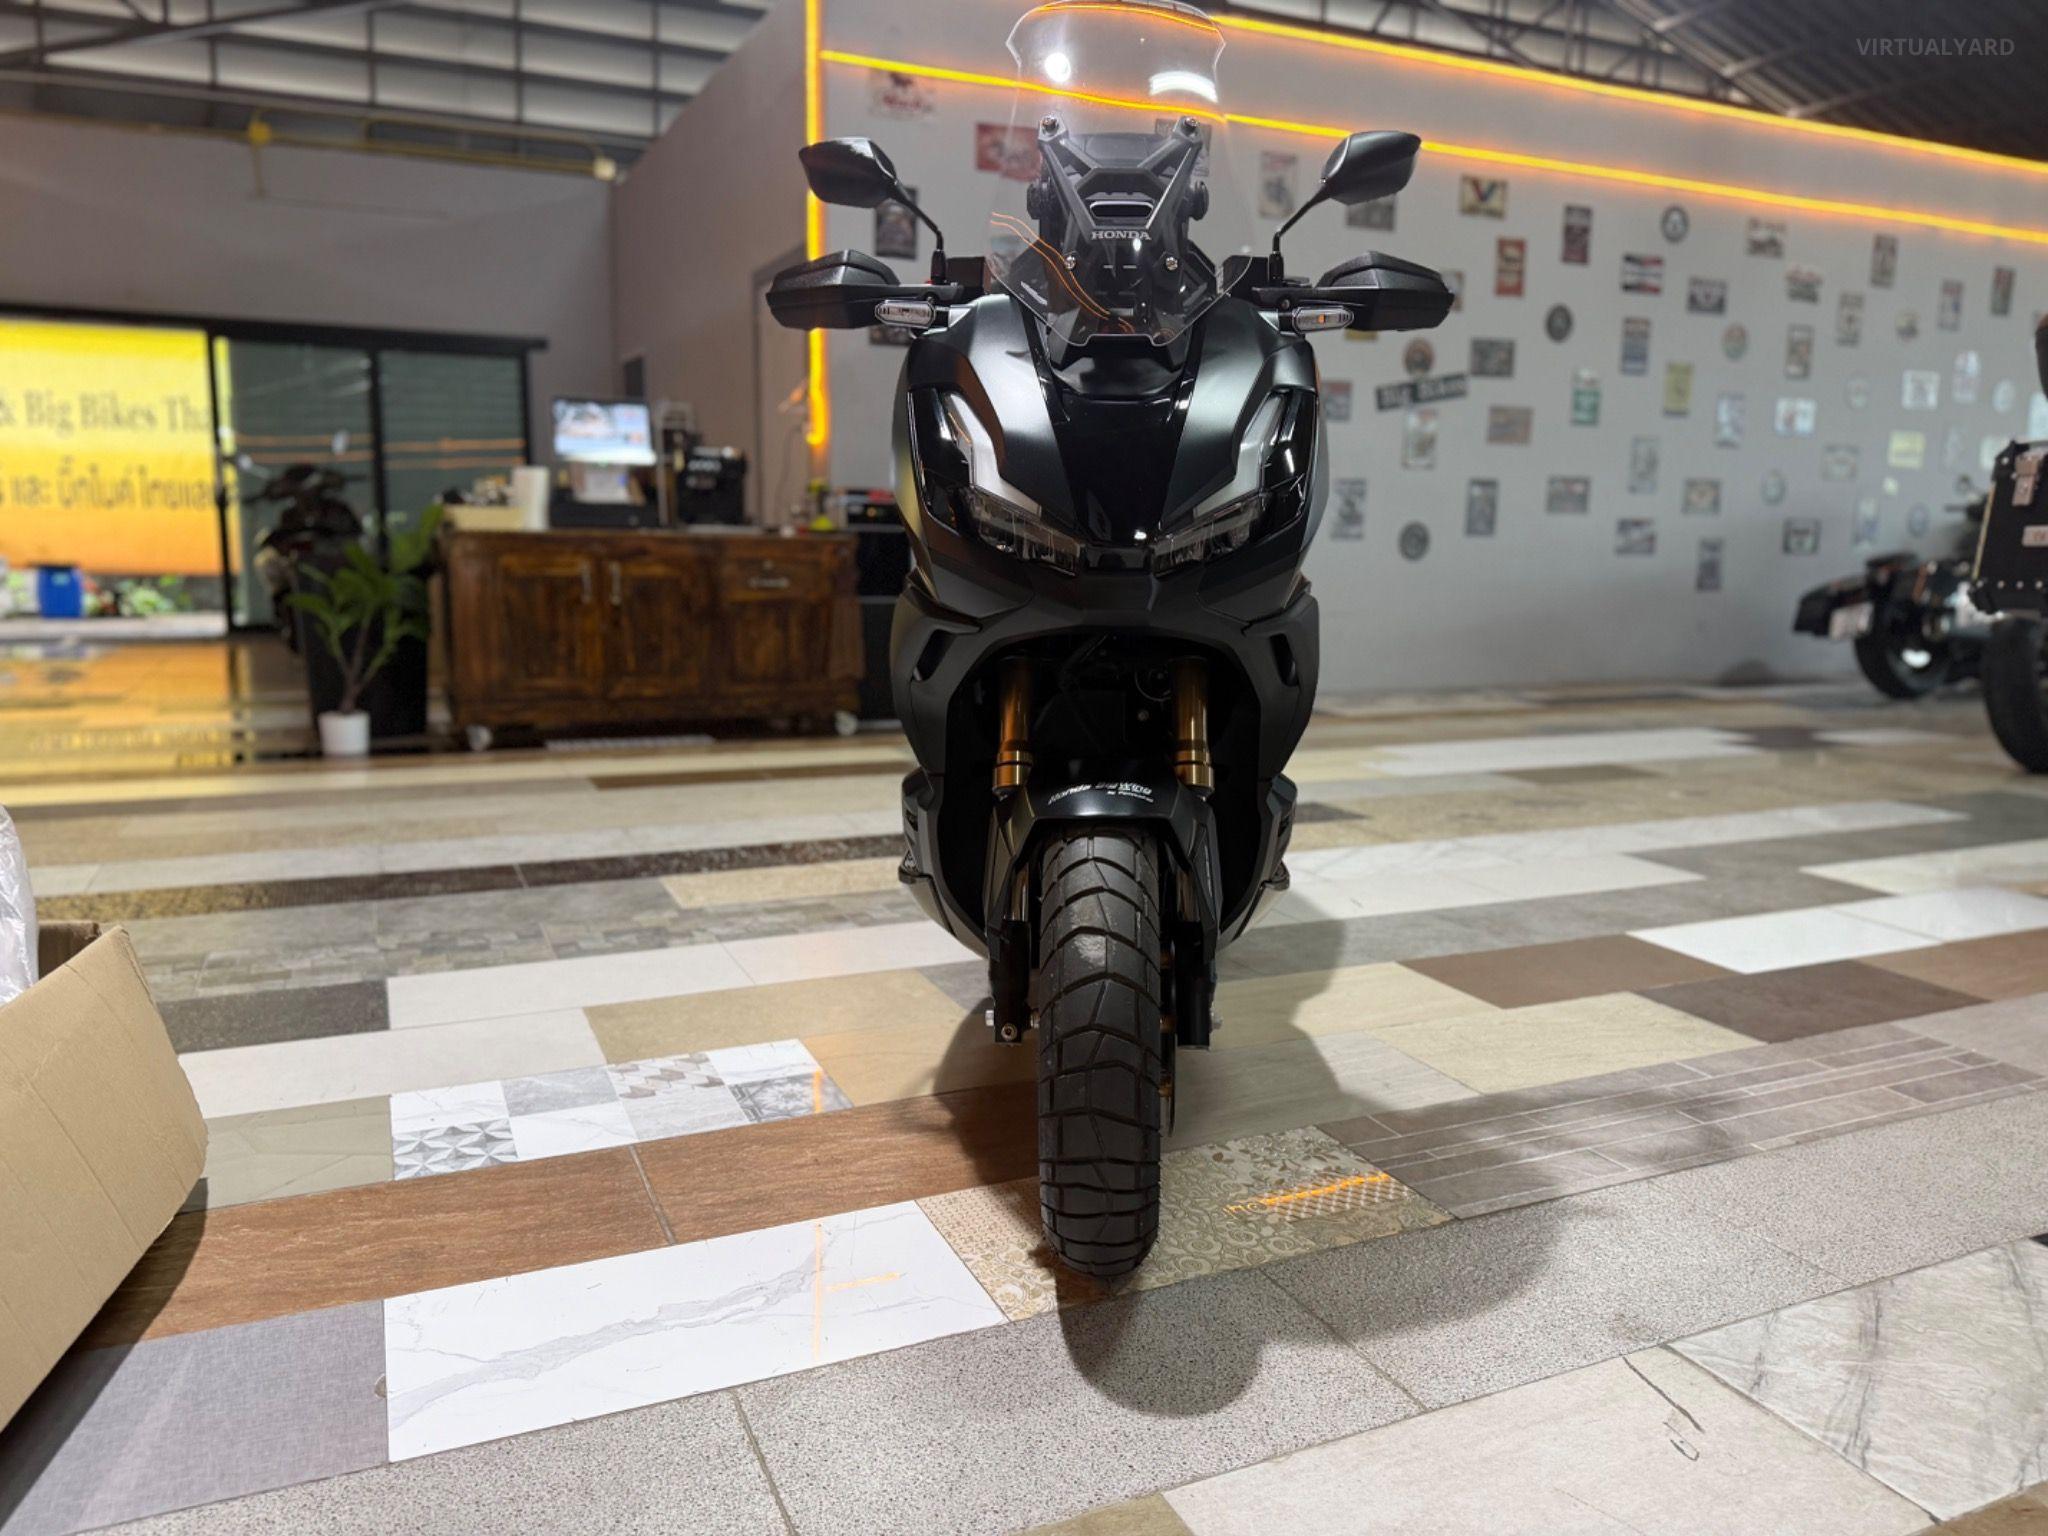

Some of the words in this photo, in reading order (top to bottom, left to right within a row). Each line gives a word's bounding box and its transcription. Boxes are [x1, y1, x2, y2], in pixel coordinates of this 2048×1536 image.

[1091, 230, 1152, 241] HONDA
[24, 388, 74, 438] Big
[79, 390, 158, 431] Bikes
